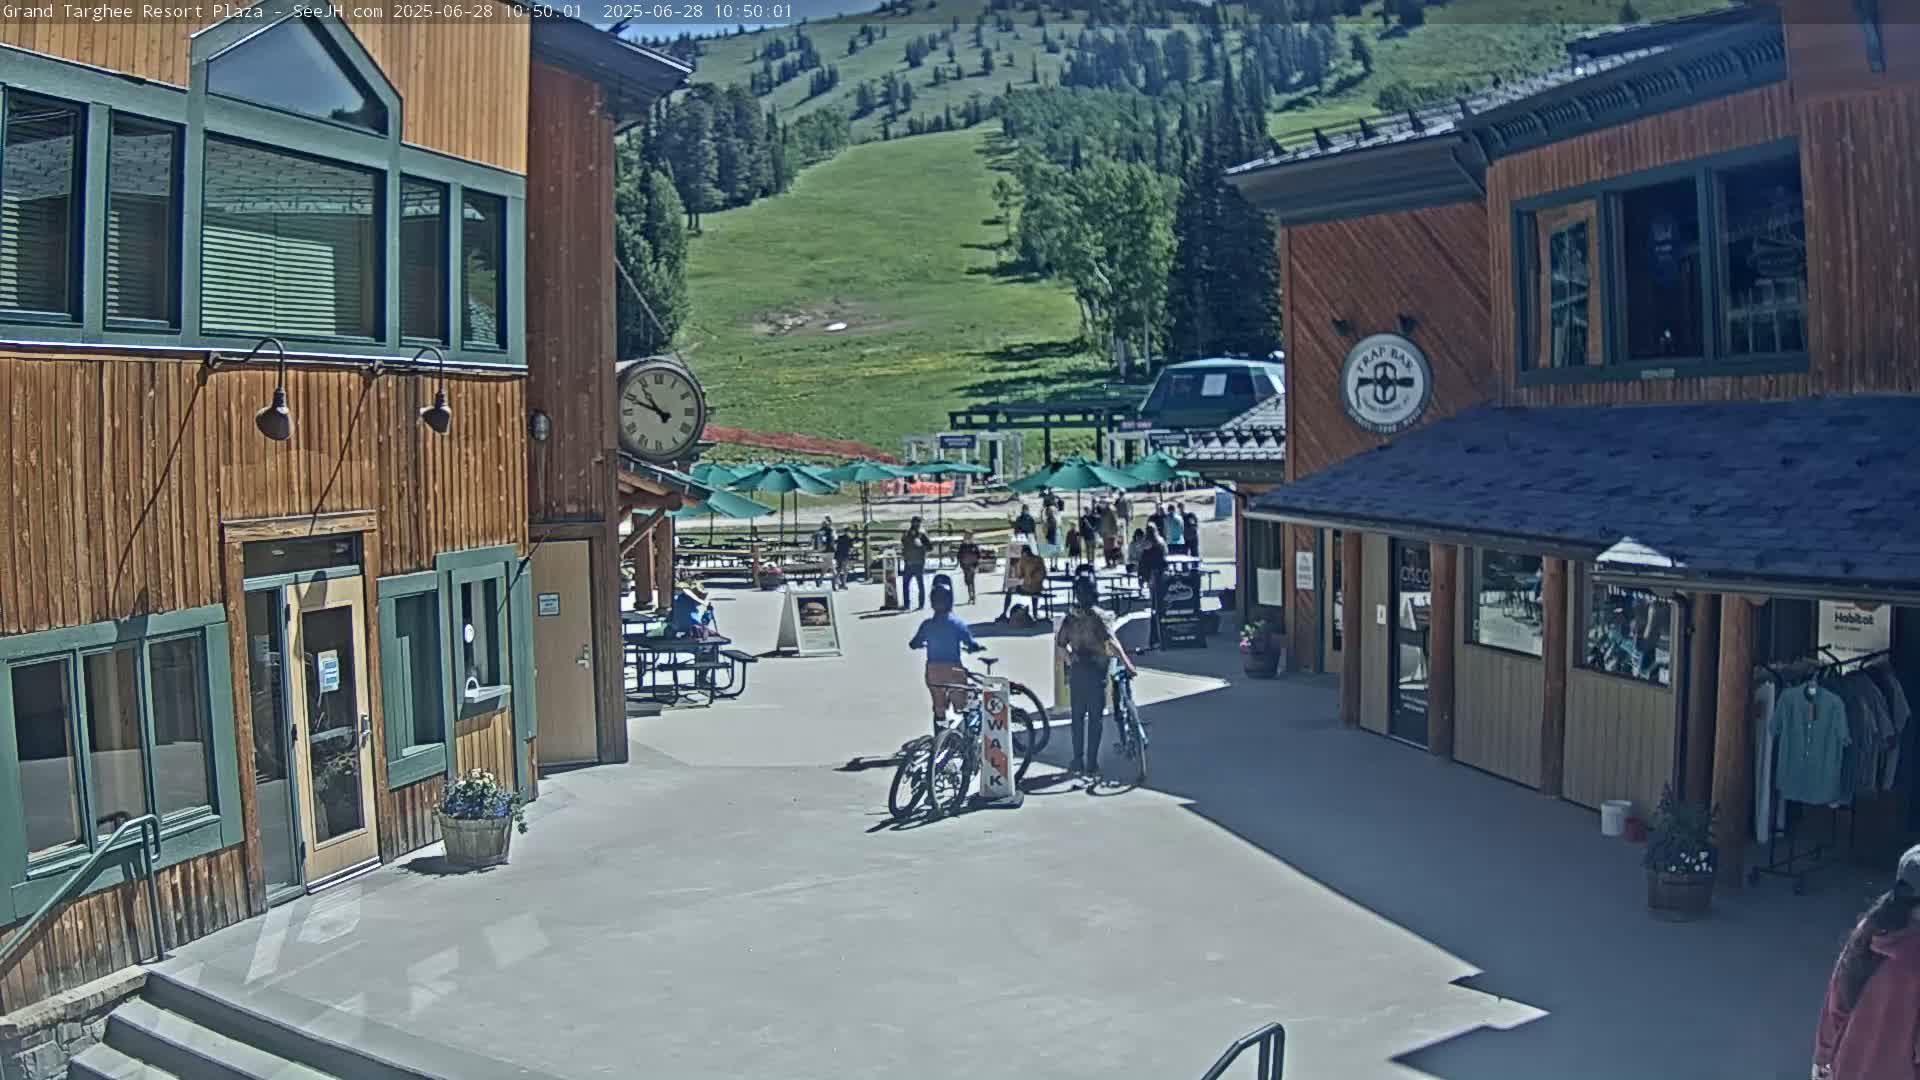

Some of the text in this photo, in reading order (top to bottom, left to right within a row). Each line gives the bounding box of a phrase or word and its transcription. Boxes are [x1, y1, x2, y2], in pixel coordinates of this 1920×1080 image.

[1357, 346, 1386, 373] TRAP
[1834, 611, 1875, 625] Habitat
[986, 719, 1005, 787] WALK
